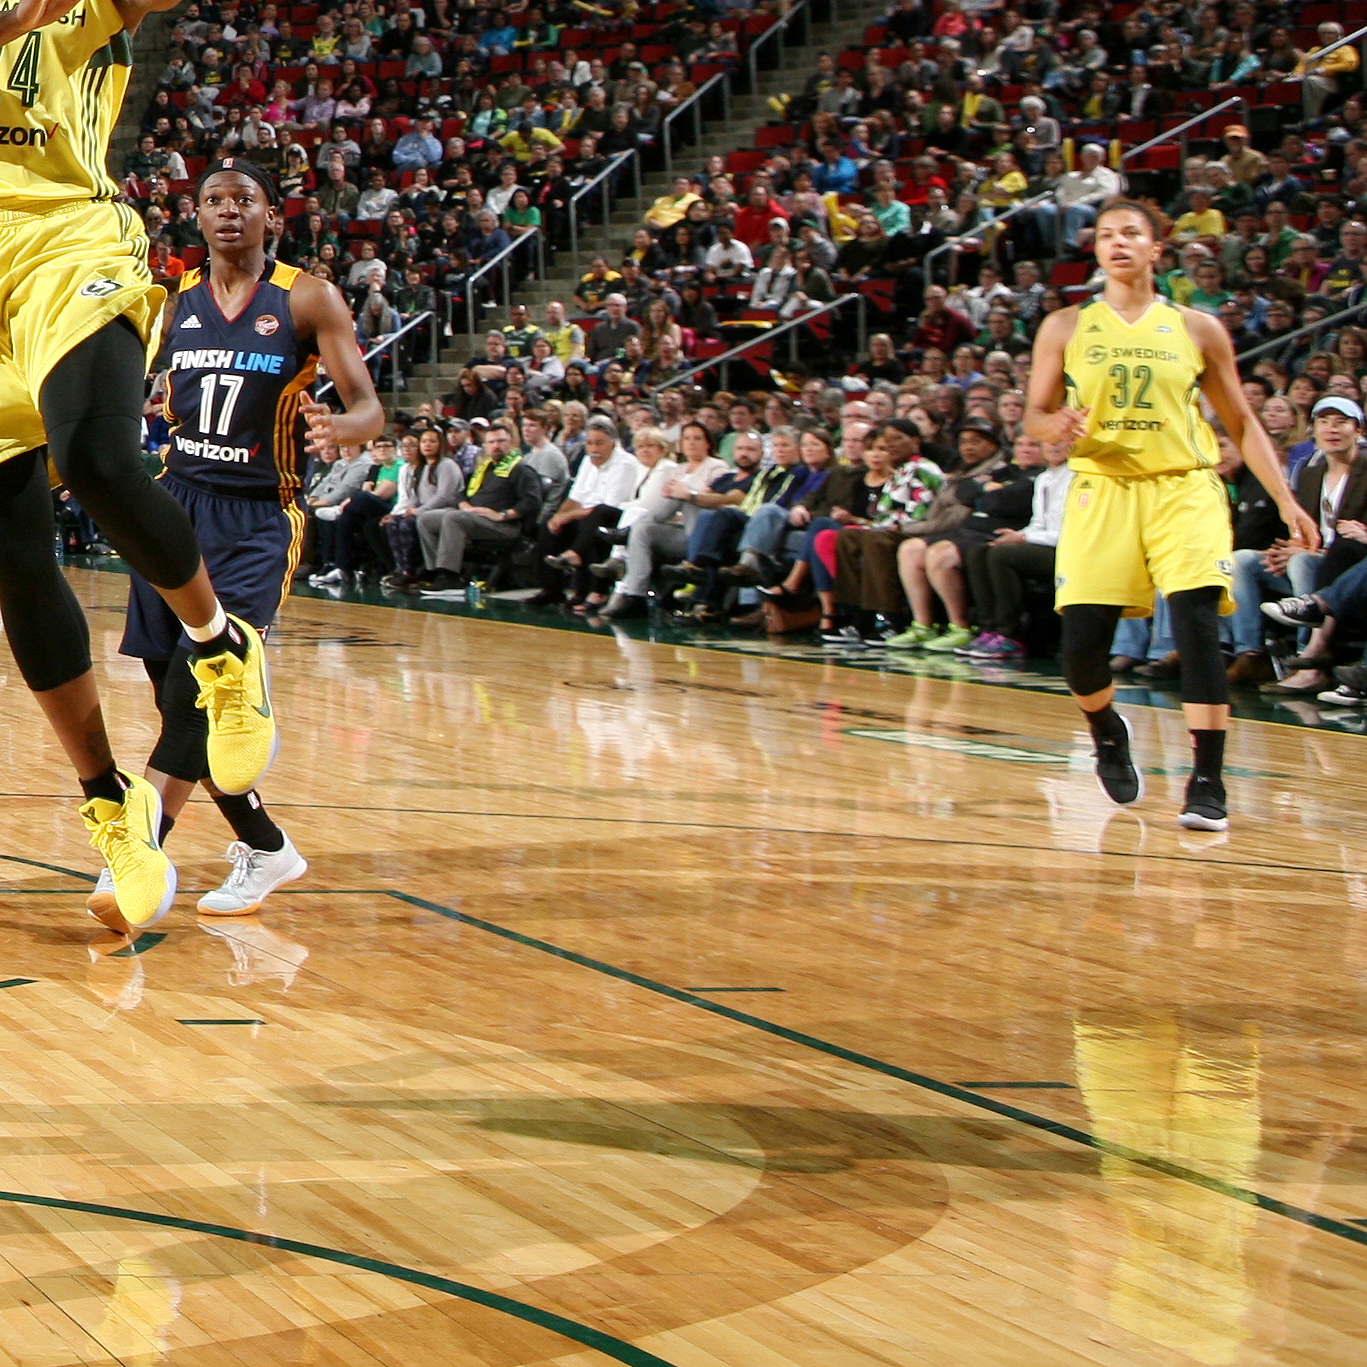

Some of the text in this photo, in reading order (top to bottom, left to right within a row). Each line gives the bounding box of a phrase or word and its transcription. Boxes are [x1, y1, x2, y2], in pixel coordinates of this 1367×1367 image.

[171, 349, 285, 375] FINISH LINE
[1110, 345, 1180, 362] SWEDISH
[1109, 363, 1152, 410] 32
[199, 372, 245, 436] 17
[1097, 418, 1163, 432] verizon
[175, 434, 250, 464] verizon
